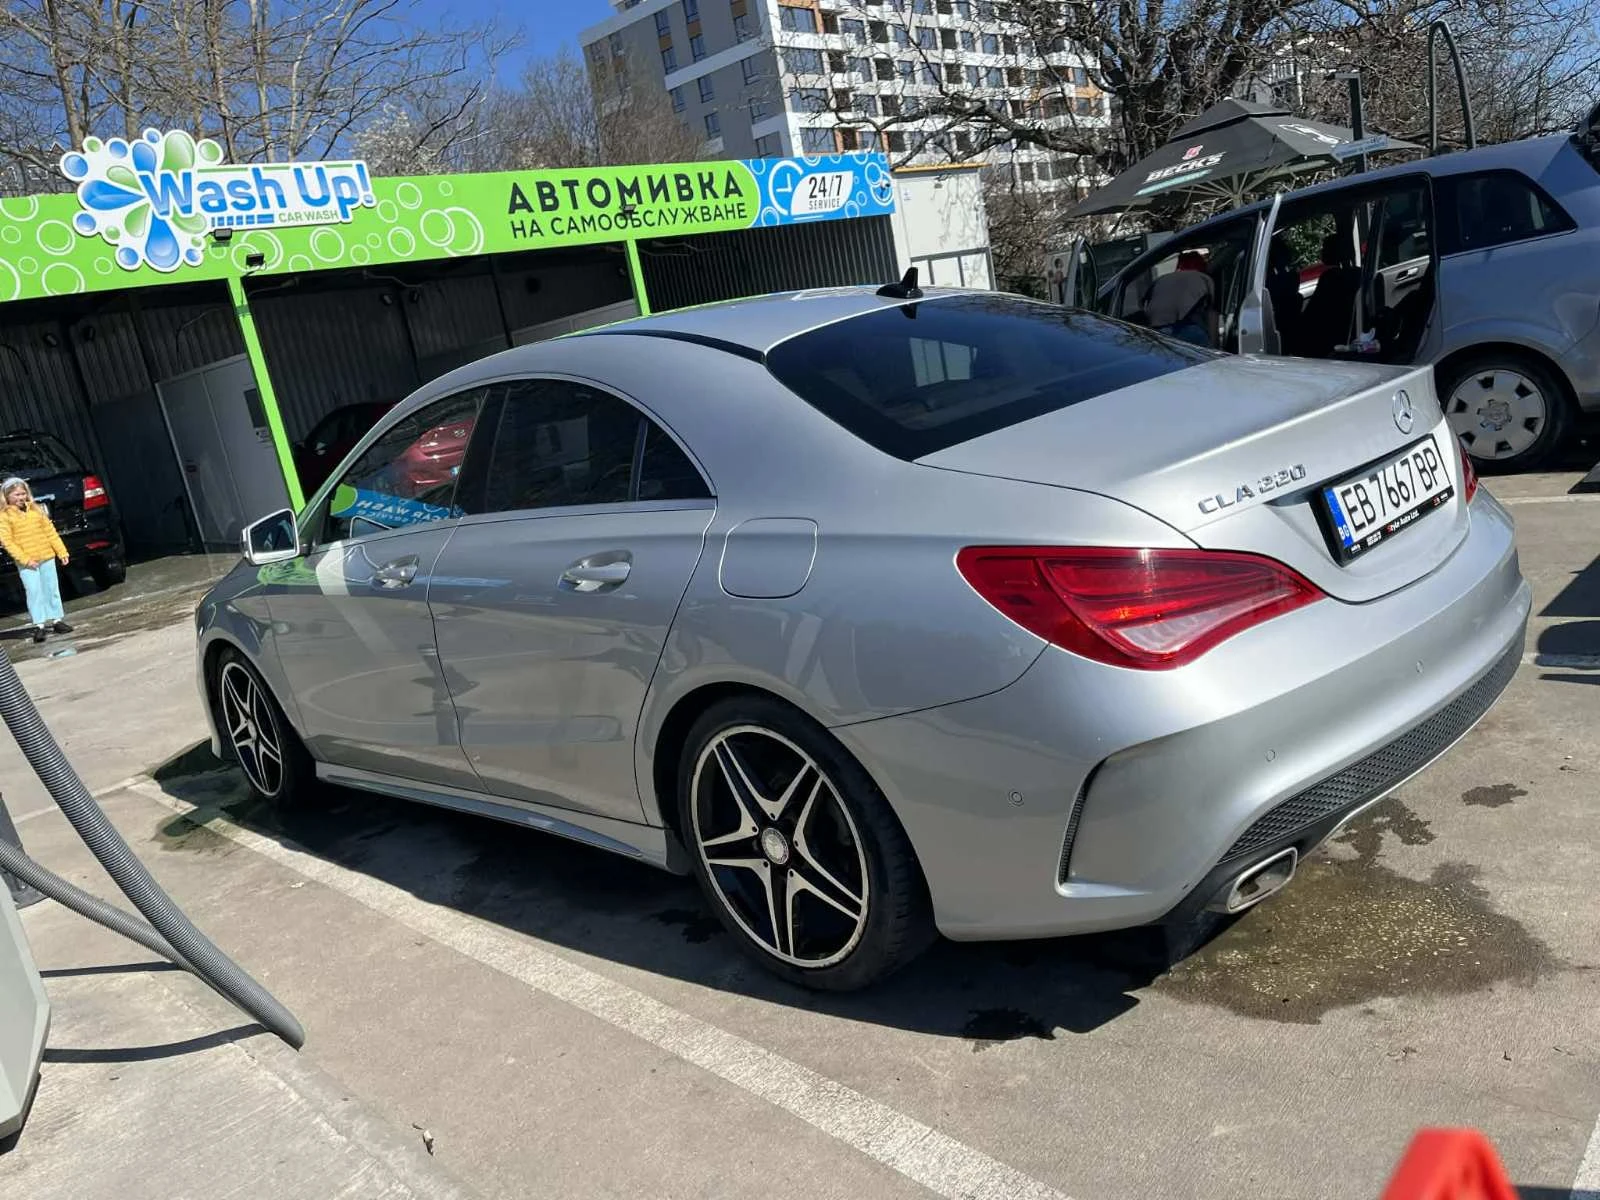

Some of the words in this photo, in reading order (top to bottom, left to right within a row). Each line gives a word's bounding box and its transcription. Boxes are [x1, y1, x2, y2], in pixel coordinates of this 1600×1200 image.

[140, 167, 287, 215] Wash
[294, 163, 374, 219] Up!
[507, 170, 744, 215] АВТОМИВКА
[808, 174, 844, 198] 24/7
[809, 198, 842, 210] SERVICE
[278, 213, 303, 223] CAR
[304, 210, 339, 221] WASH
[511, 220, 544, 239] НА
[551, 203, 747, 234] САМООБСЛУЖВАНЕ
[1198, 483, 1255, 514] CLA
[1258, 463, 1306, 493] 220
[1341, 482, 1377, 533] EB
[1368, 457, 1417, 517] 7667
[1412, 447, 1438, 492] BP
[1337, 524, 1350, 541] BG
